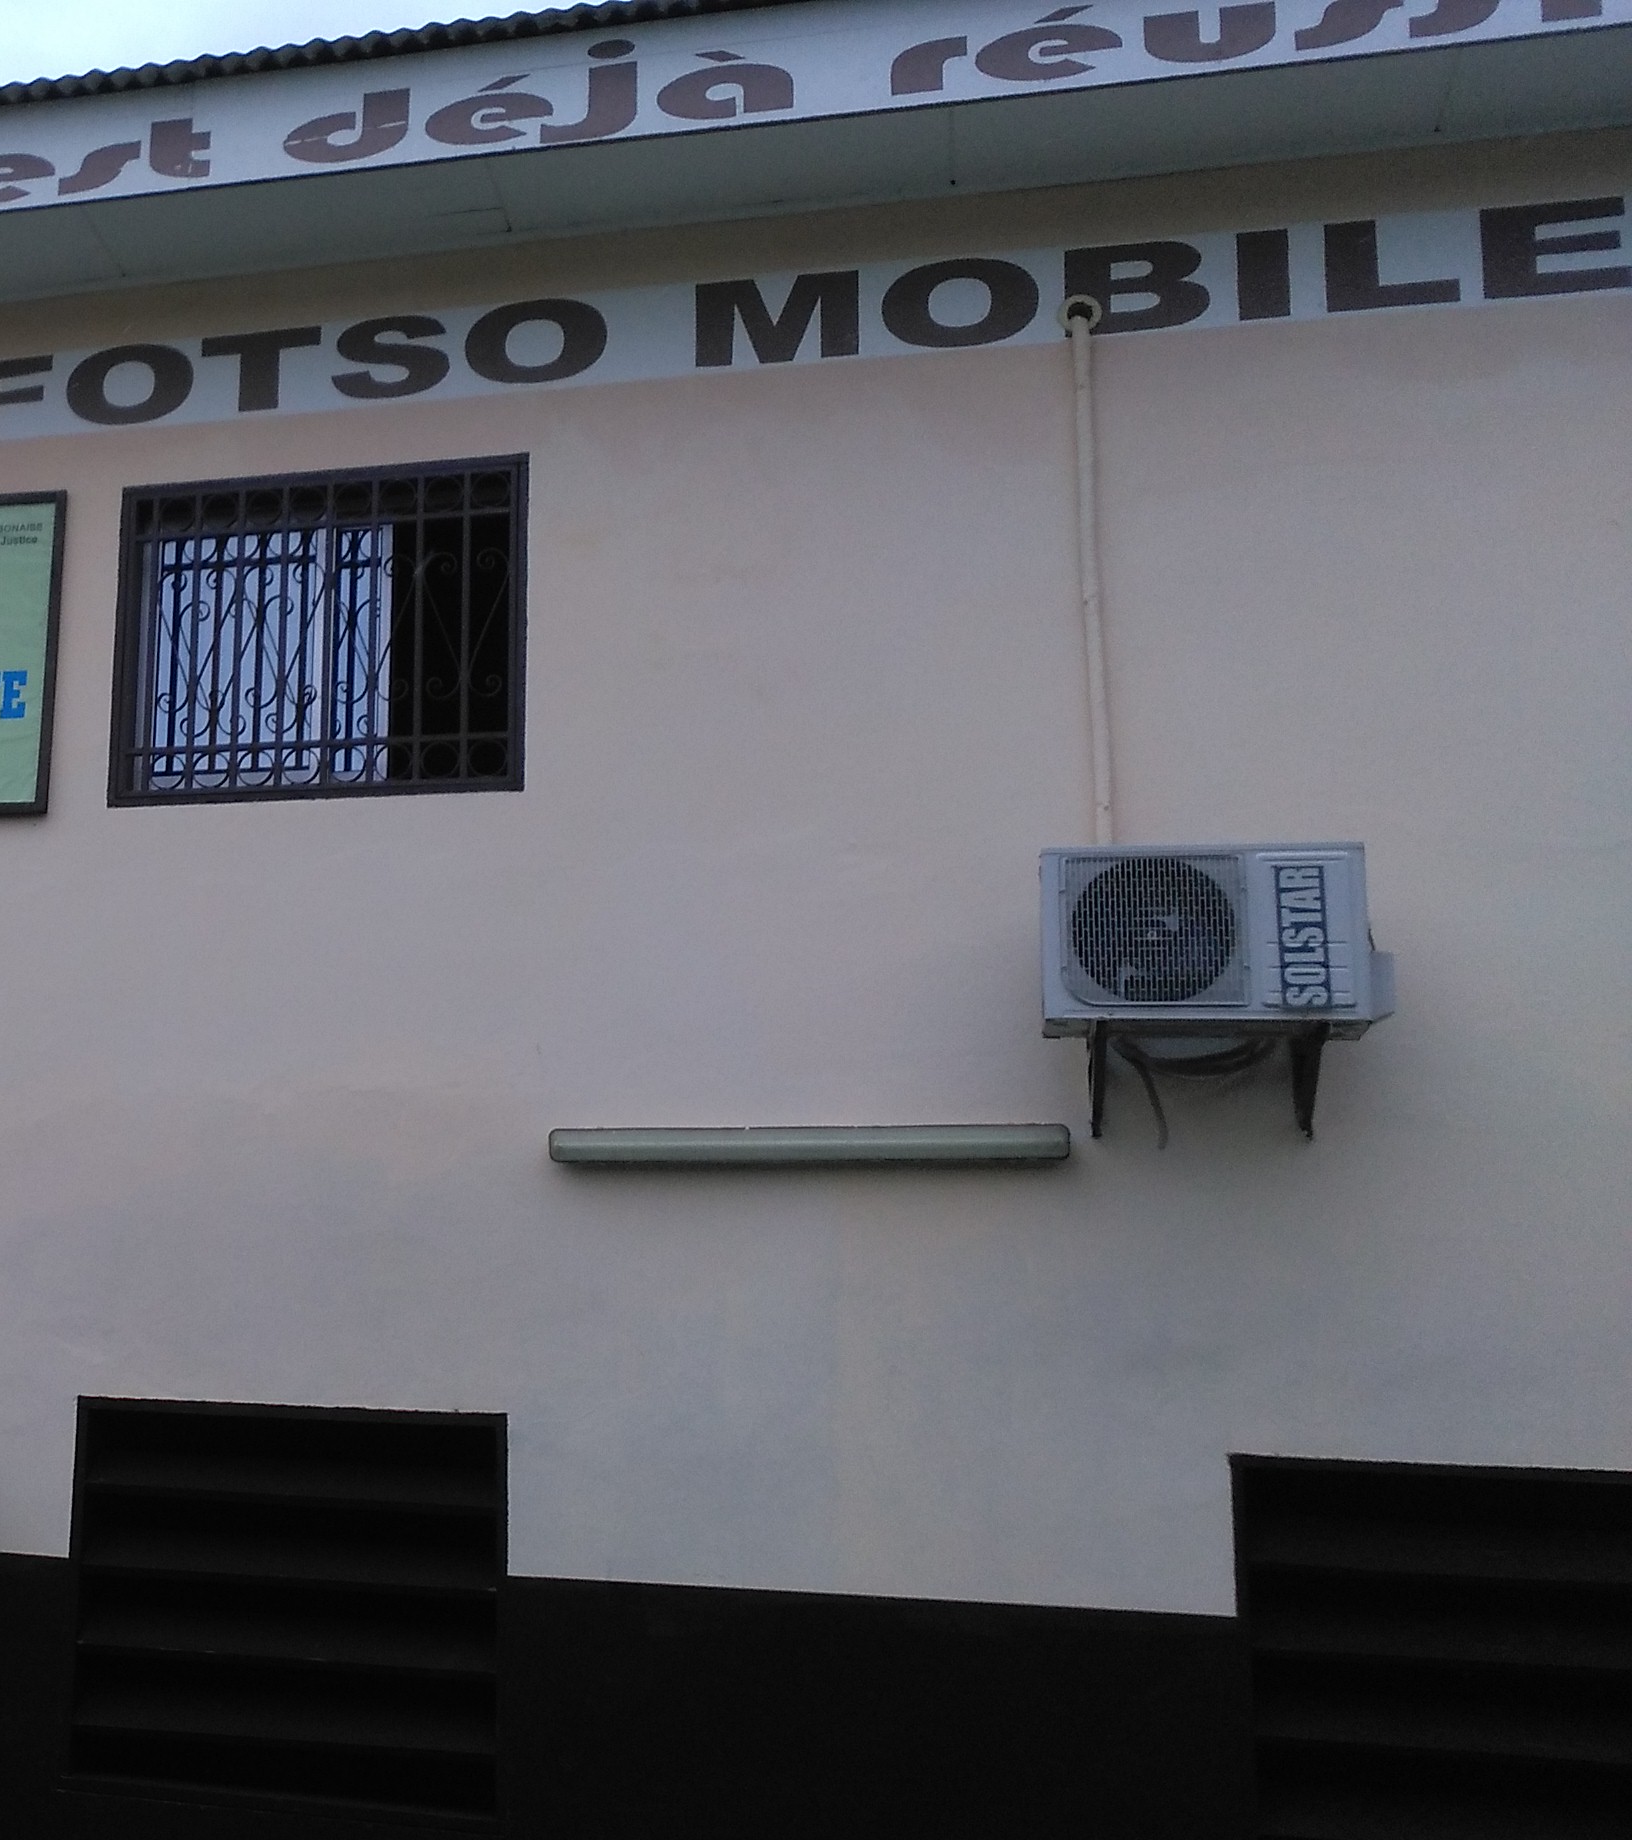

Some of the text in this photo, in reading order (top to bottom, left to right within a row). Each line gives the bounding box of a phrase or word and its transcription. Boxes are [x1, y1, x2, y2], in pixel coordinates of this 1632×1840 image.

[283, 39, 794, 163] déjà
[695, 197, 1632, 367] MOBILE
[0, 535, 38, 546] Justice
[1279, 866, 1329, 1009] SOLSTAR
